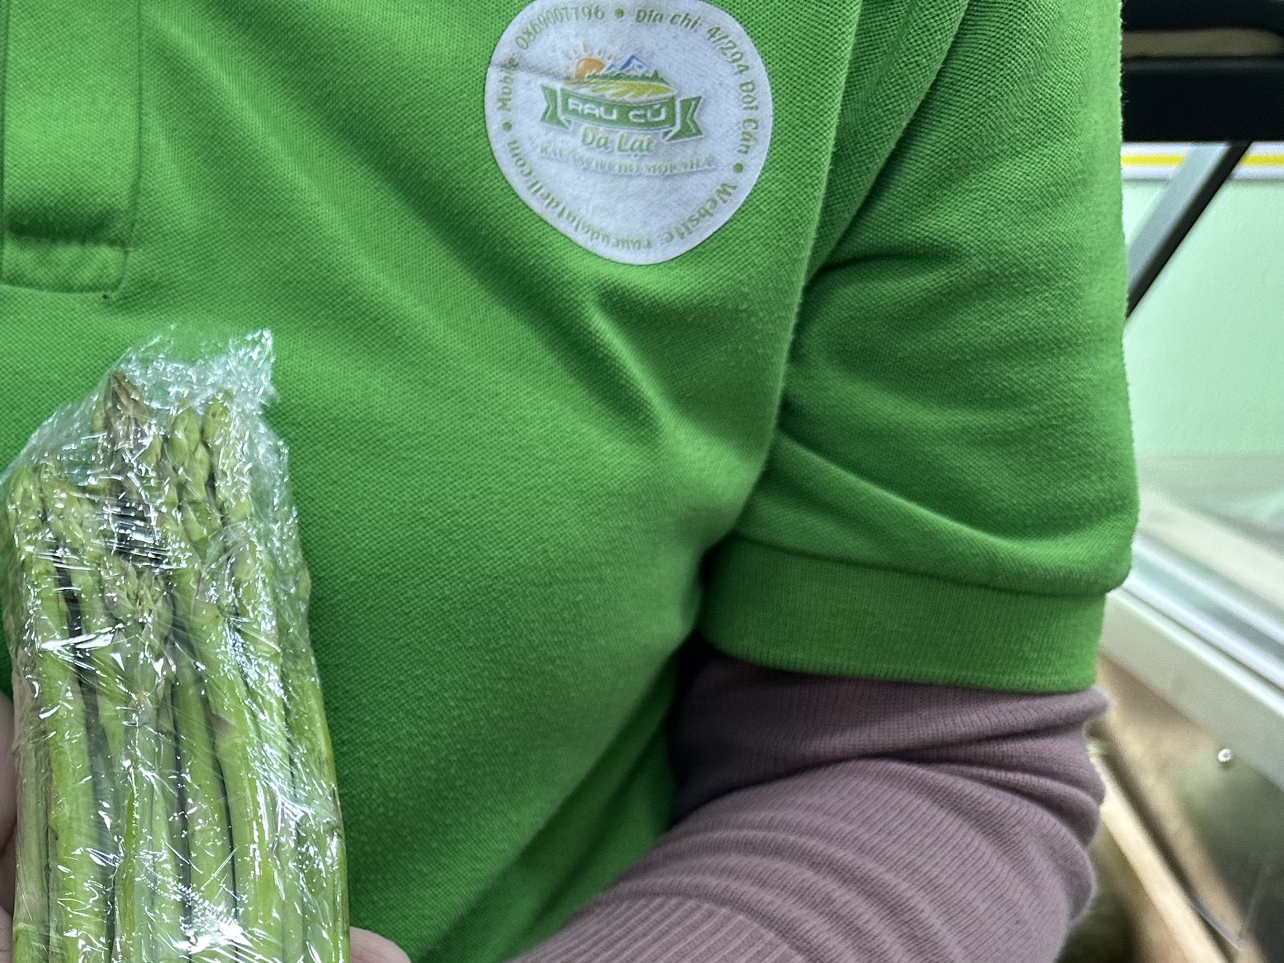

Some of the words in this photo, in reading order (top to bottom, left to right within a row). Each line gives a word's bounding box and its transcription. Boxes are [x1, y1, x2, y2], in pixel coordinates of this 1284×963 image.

[706, 26, 750, 76] 4/294
[568, 98, 617, 120] RAU
[628, 104, 666, 123] CỦ
[581, 125, 610, 150] Đà
[617, 132, 654, 158] Lạt
